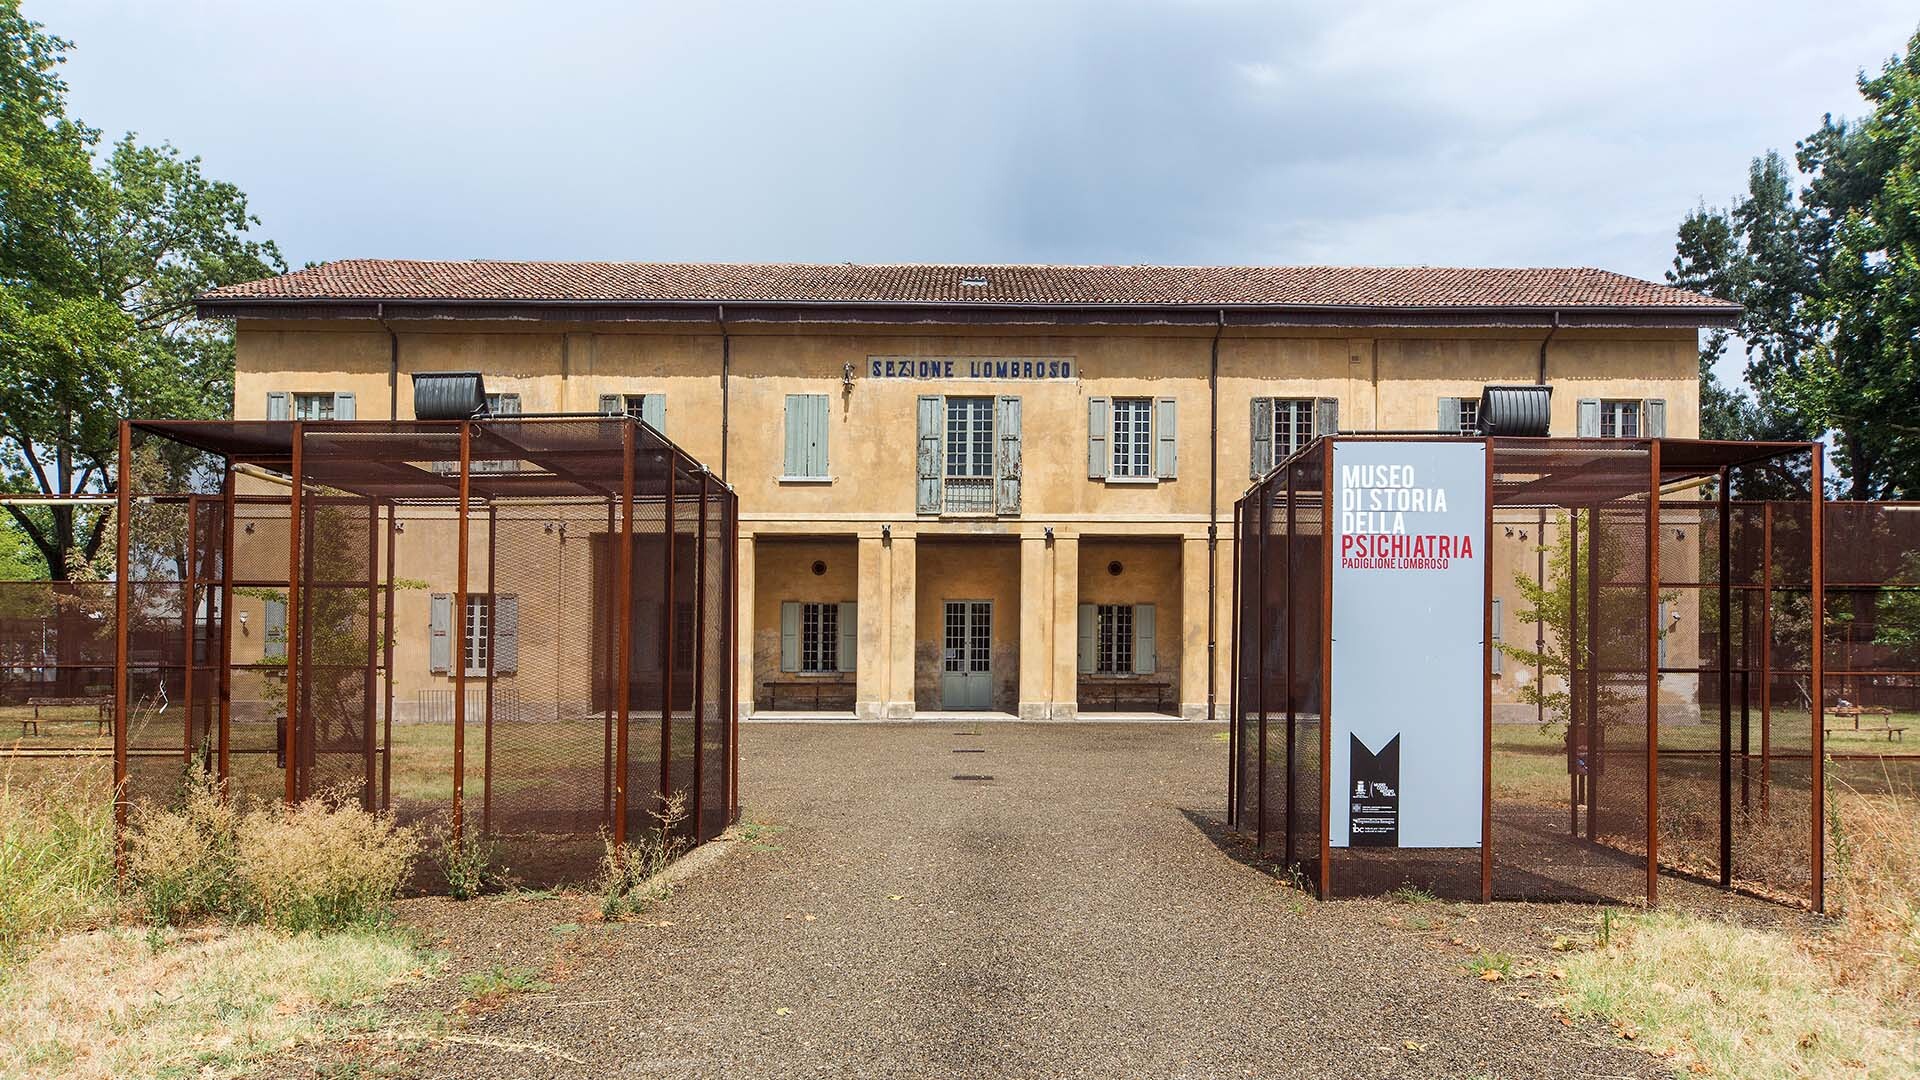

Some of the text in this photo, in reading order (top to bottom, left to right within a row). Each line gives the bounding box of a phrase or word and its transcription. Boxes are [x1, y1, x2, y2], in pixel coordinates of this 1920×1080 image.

[872, 360, 1071, 379] SEZIONE LOMBROSO
[1342, 465, 1415, 488] MUSEO
[1342, 488, 1447, 512] DI STORIA
[1342, 511, 1406, 534] DELLA
[1341, 535, 1473, 558] PSICHIATRIA
[1342, 558, 1449, 569] PADIGLIONE LOMBROSO
